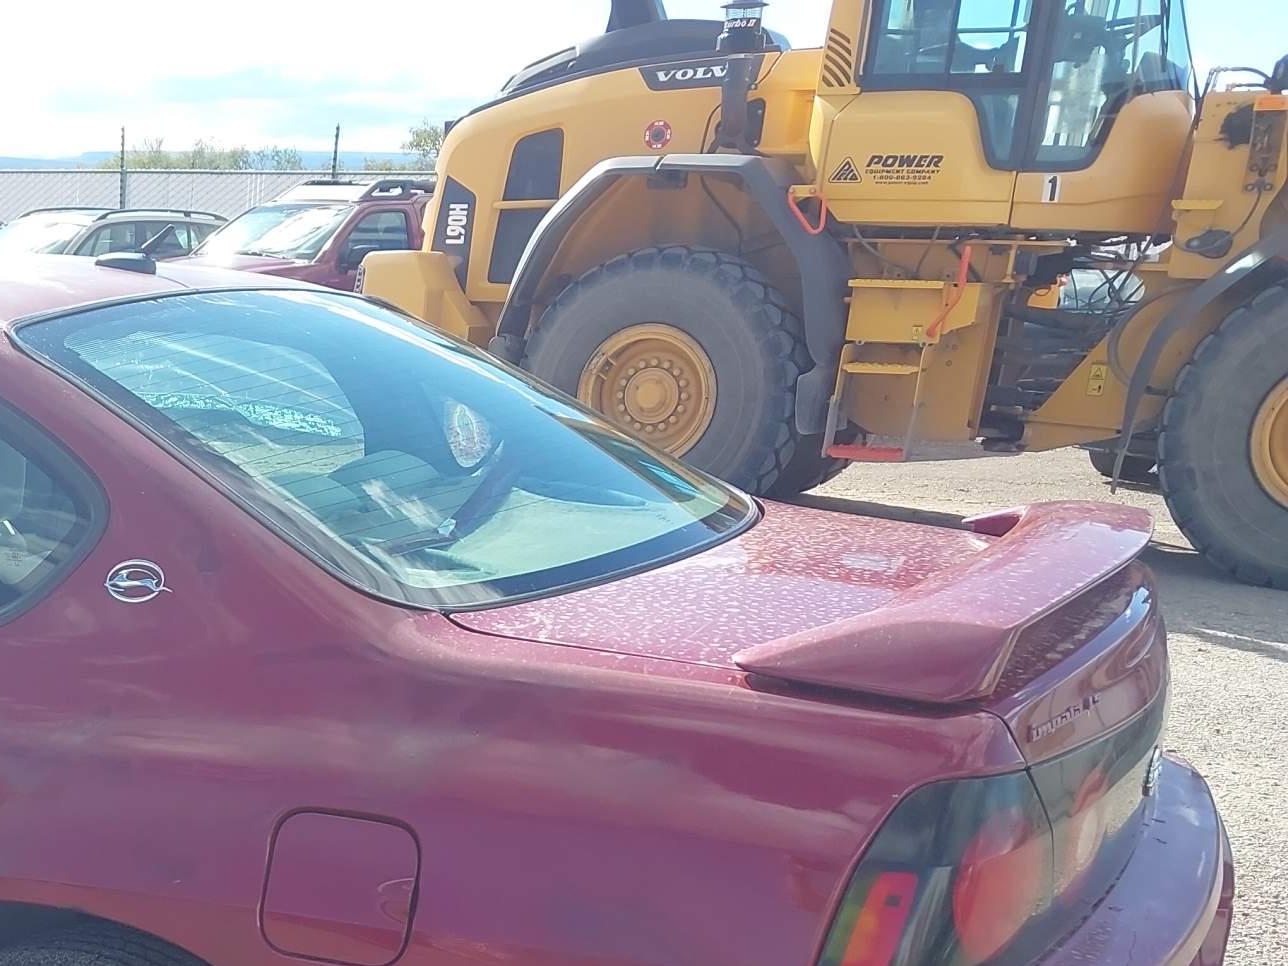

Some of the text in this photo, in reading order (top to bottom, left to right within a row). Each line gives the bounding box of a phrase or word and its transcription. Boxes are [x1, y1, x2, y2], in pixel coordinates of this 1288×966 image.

[655, 65, 728, 82] VOLV
[866, 155, 944, 168] POWER
[1048, 175, 1058, 202] 1
[445, 203, 469, 245] L90H
